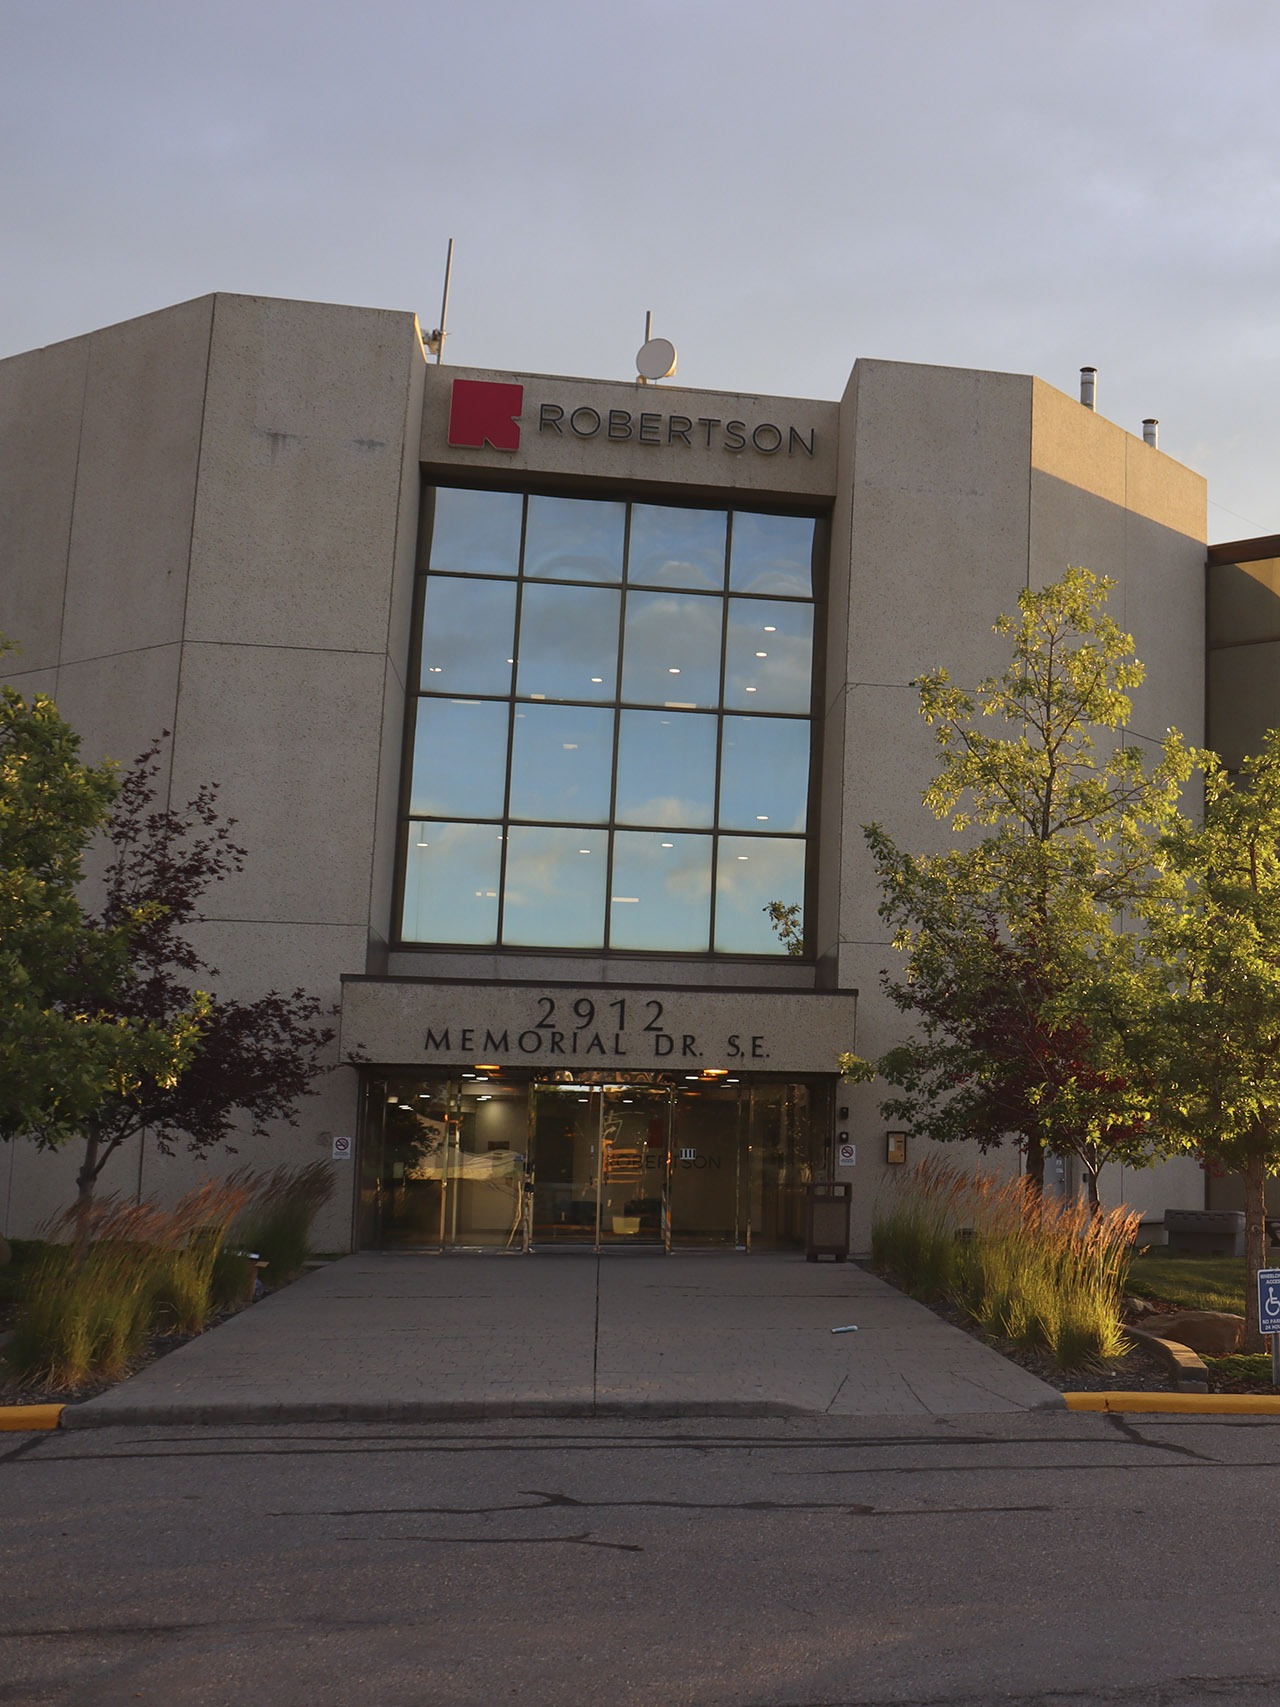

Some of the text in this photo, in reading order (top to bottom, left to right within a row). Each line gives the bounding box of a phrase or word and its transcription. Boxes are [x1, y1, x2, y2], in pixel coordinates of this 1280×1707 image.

[537, 403, 816, 457] ROBERTSON
[534, 996, 664, 1032] 2912
[424, 1027, 771, 1058] MEMORIAL DR. S.E.
